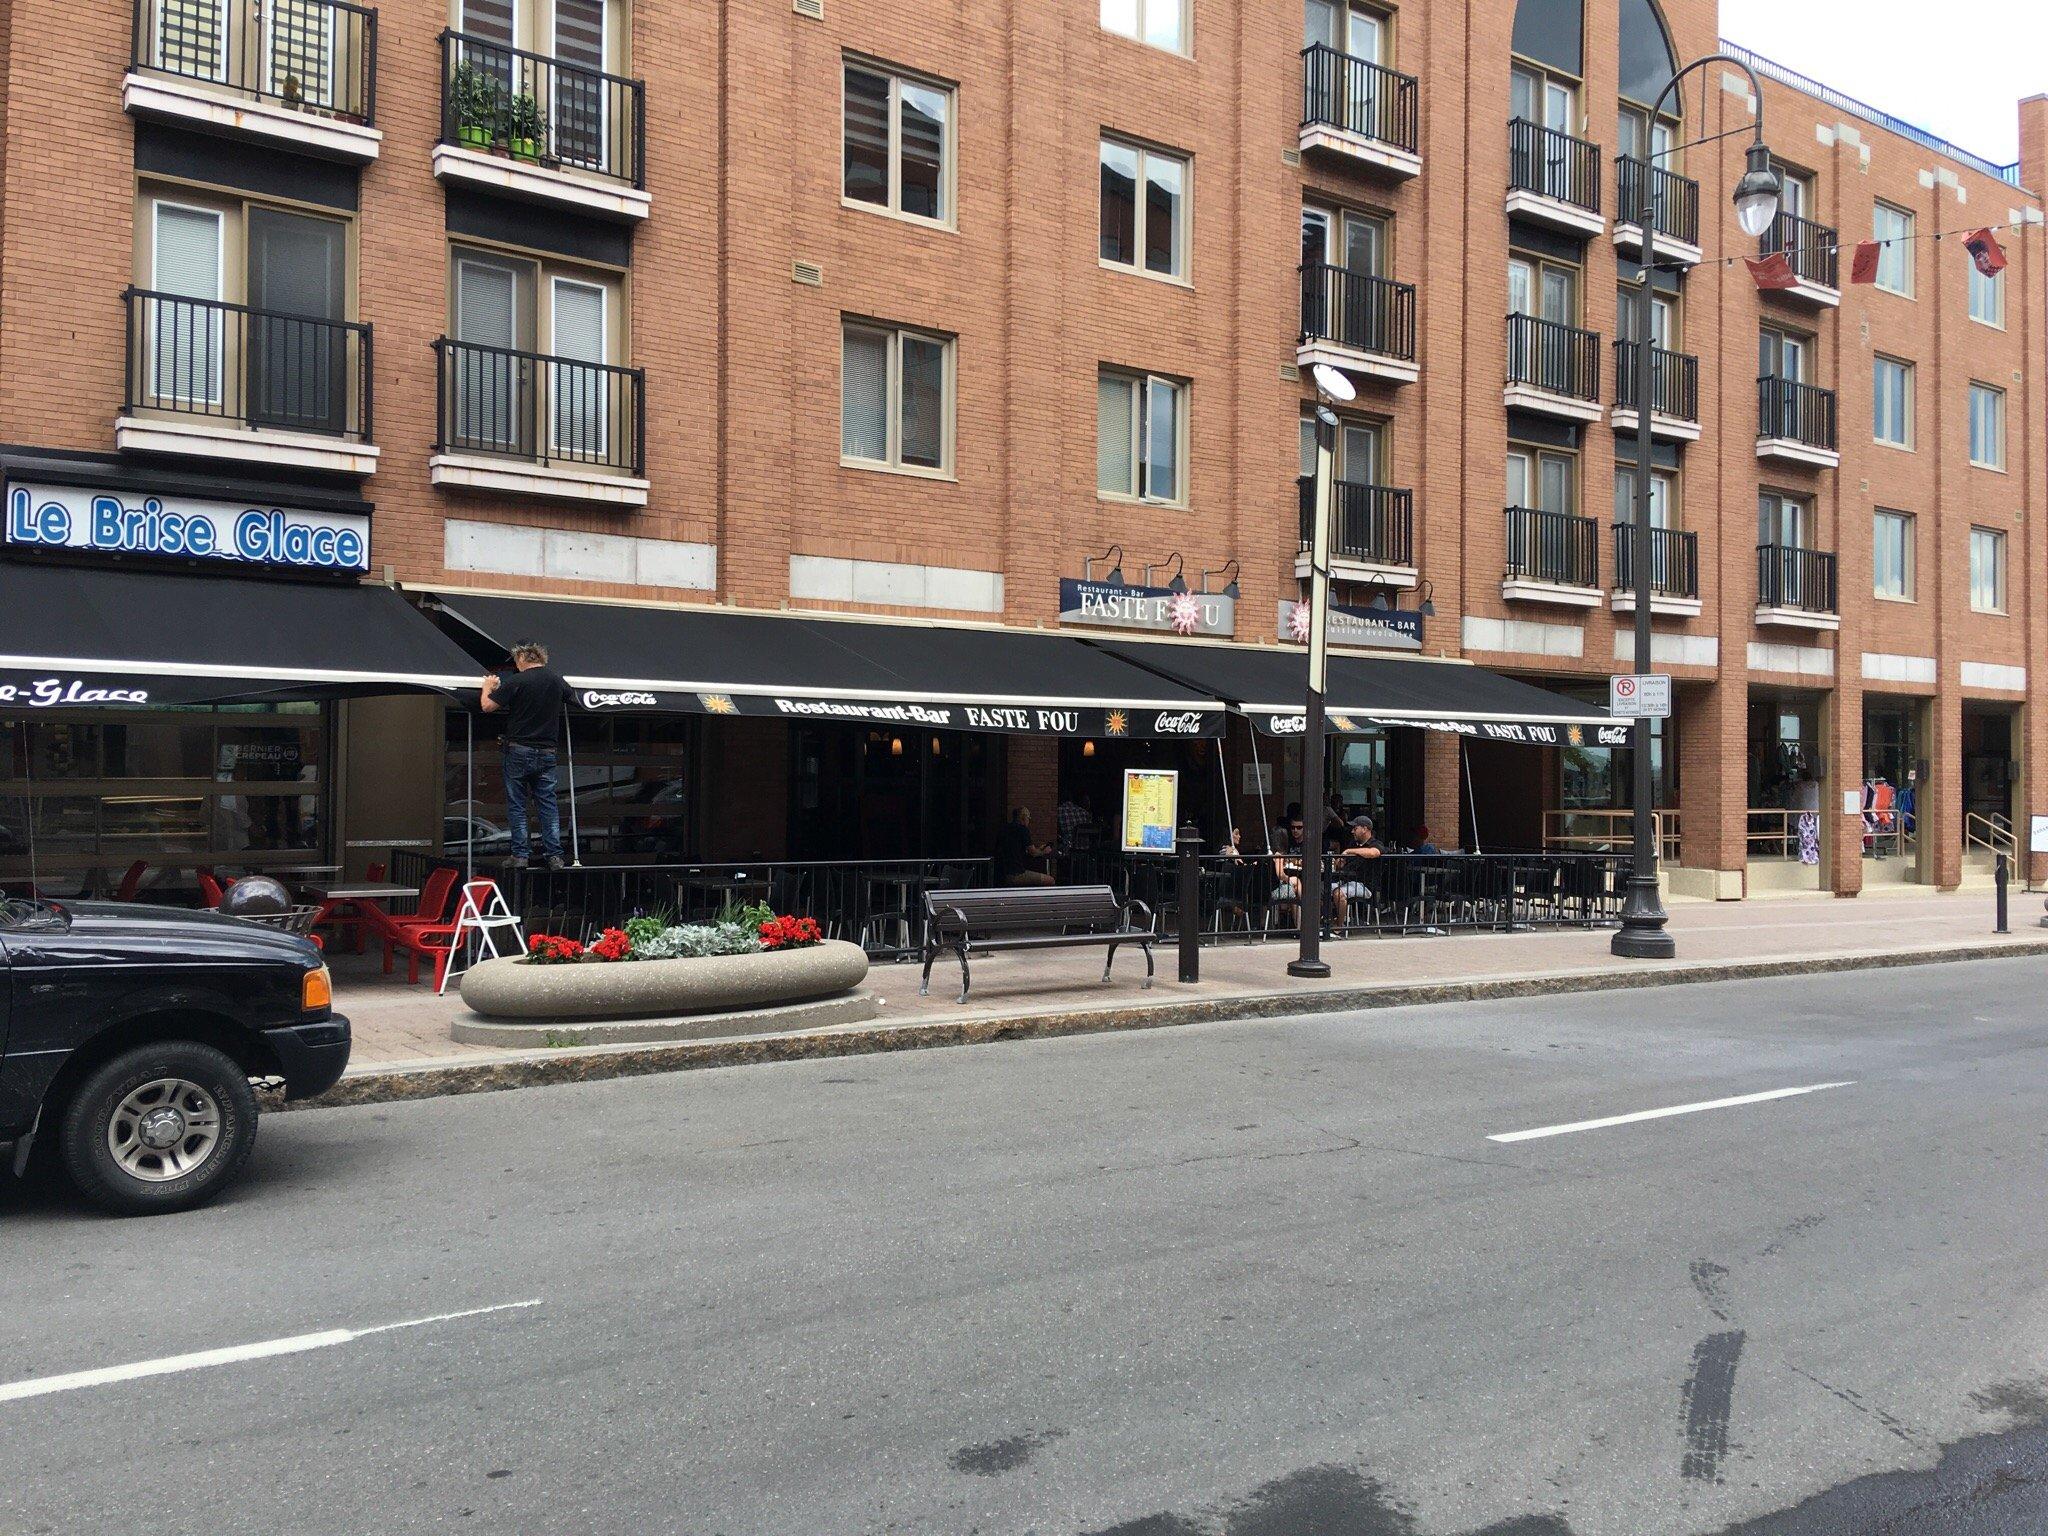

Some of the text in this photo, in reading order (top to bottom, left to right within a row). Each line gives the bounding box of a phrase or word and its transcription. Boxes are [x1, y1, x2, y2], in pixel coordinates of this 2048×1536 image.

[11, 487, 365, 568] Le Brise Glace
[1078, 584, 1122, 596] Restaurant
[1131, 590, 1144, 598] Bar
[1080, 592, 1148, 621] FASTE
[1397, 621, 1416, 631] BAR
[583, 690, 658, 709] Coca-Cola
[774, 699, 950, 724] Restaurant-Bar
[964, 707, 1079, 732] FASTE FOU
[1154, 711, 1203, 733] Coca-Cola
[1482, 723, 1527, 741] FASTE
[1527, 726, 1557, 743] FOU
[1597, 726, 1628, 744] Coca-Cola
